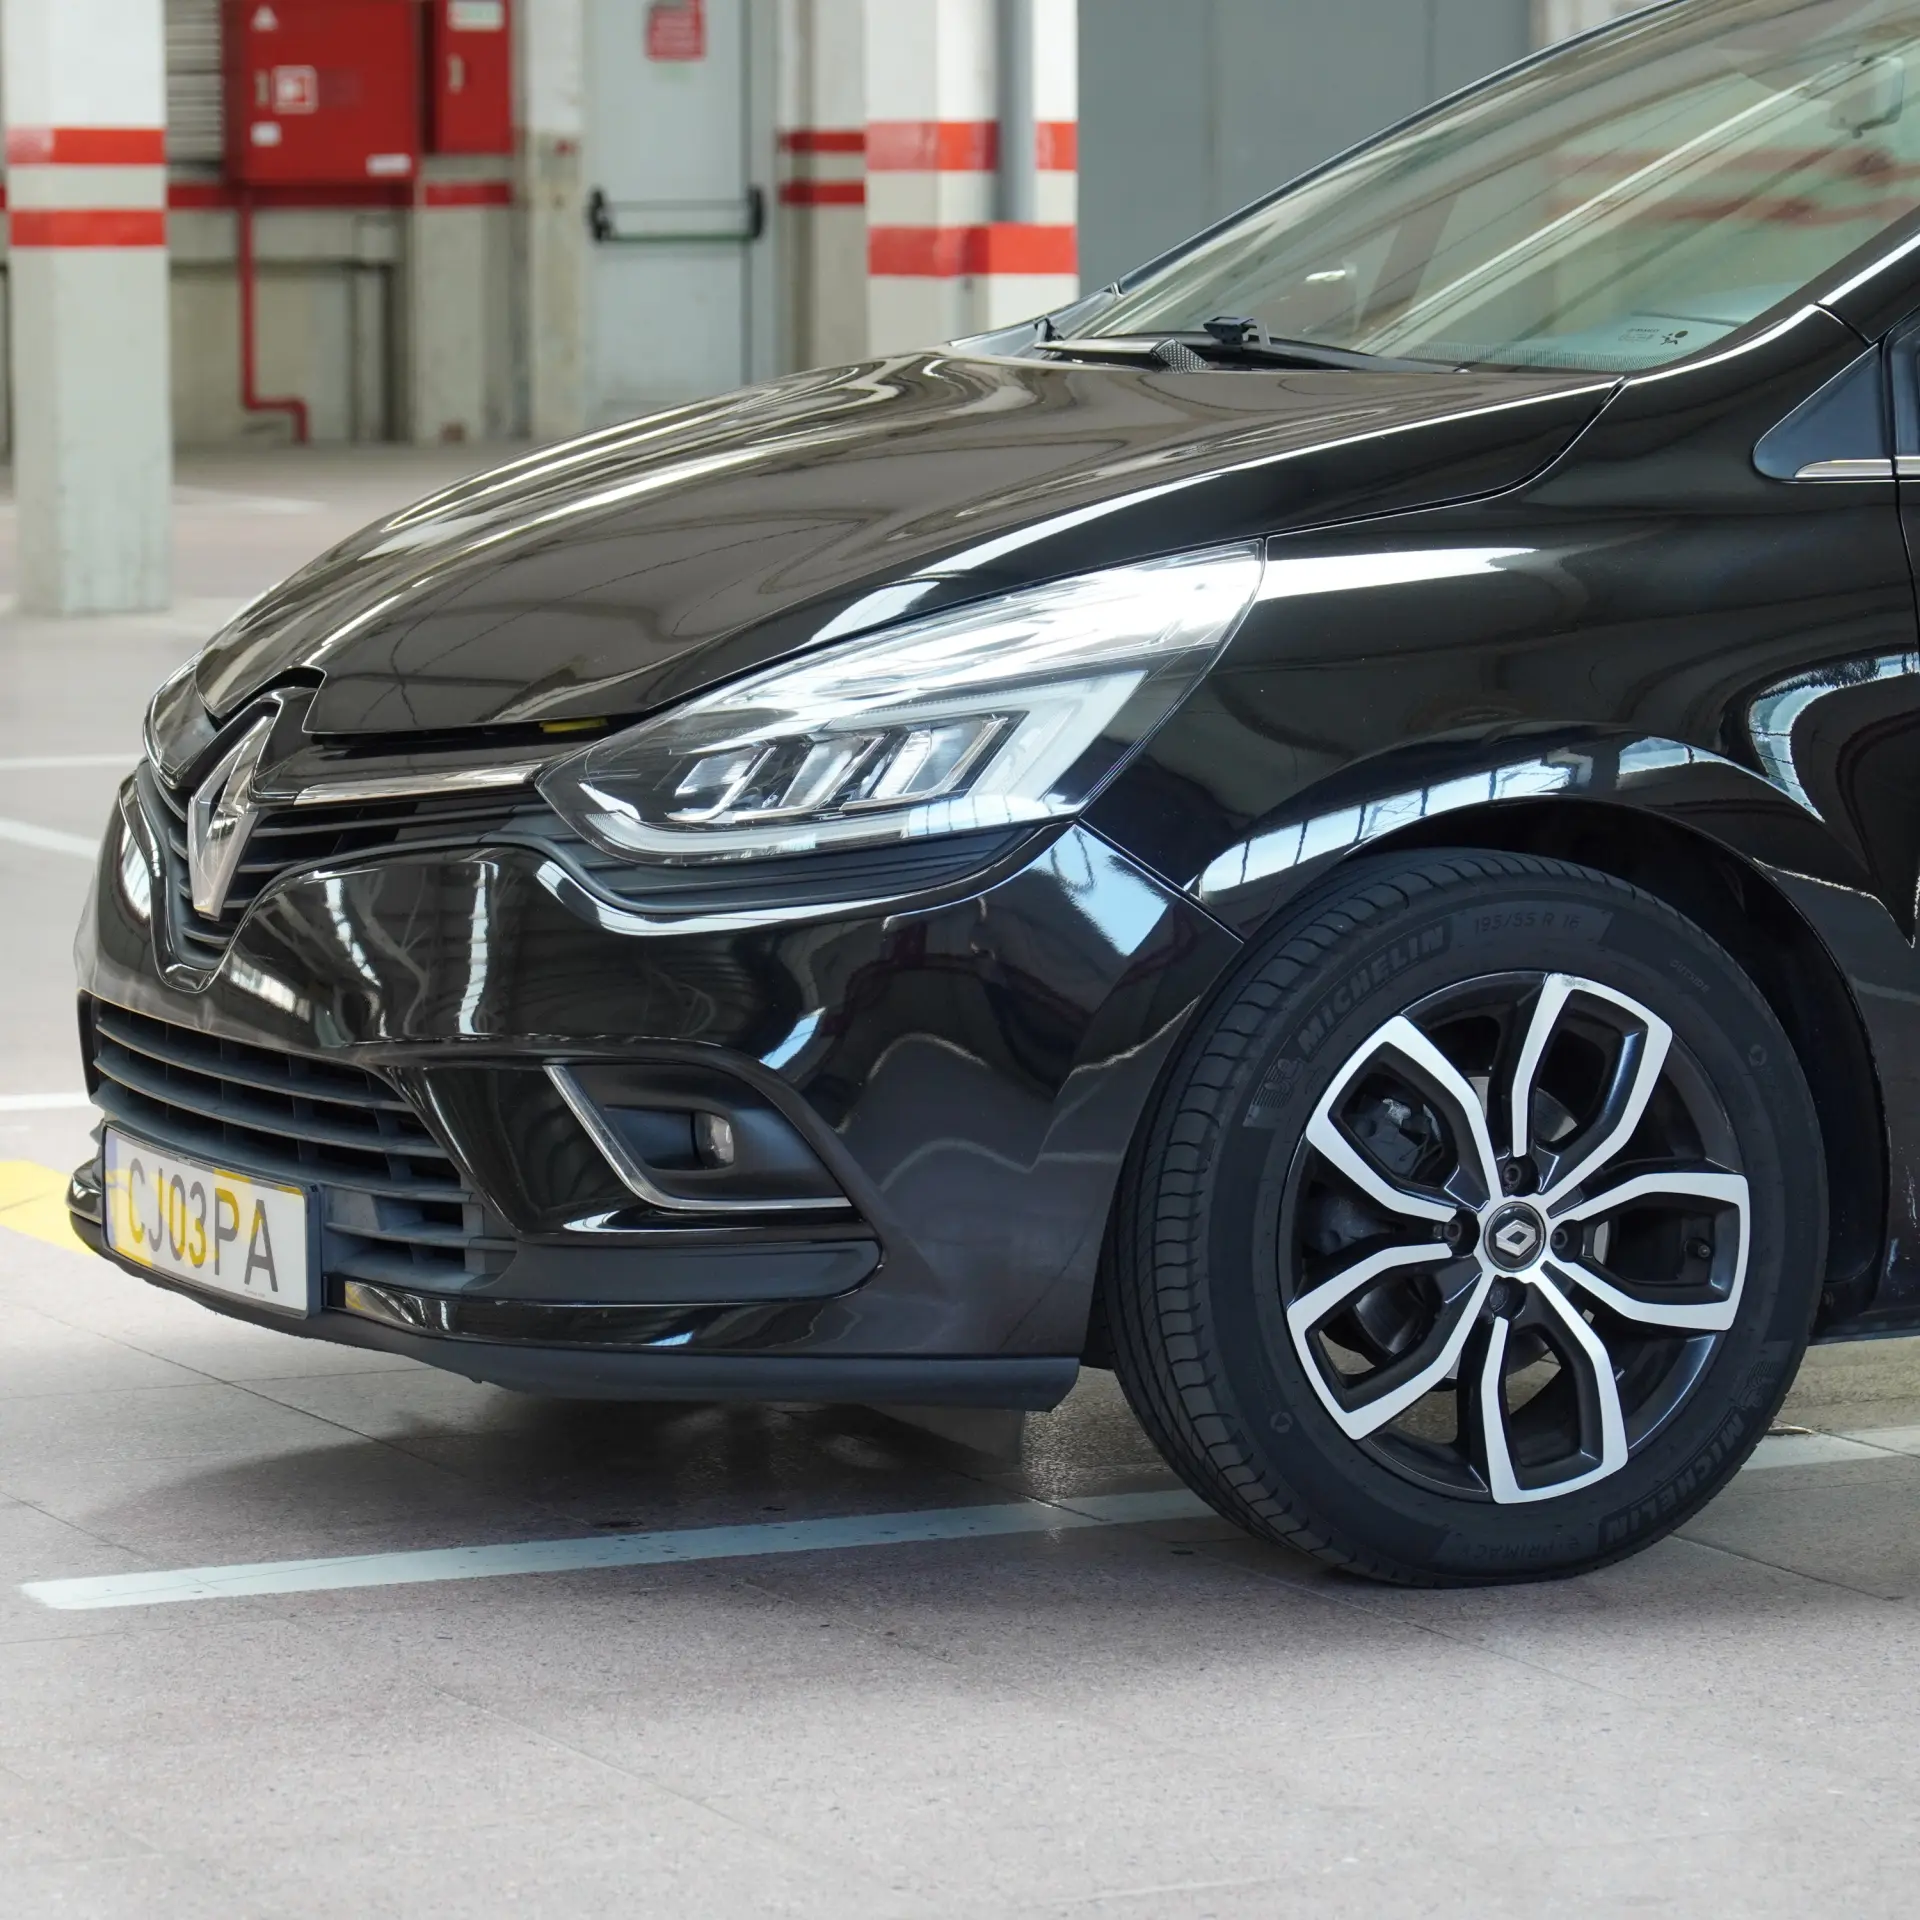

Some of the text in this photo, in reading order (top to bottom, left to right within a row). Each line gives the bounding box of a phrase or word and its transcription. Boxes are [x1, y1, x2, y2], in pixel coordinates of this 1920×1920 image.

[1474, 910, 1580, 935] 195/55 R 16
[1298, 924, 1444, 1048] MICHELIN
[1605, 1414, 1745, 1542] MICHELIN
